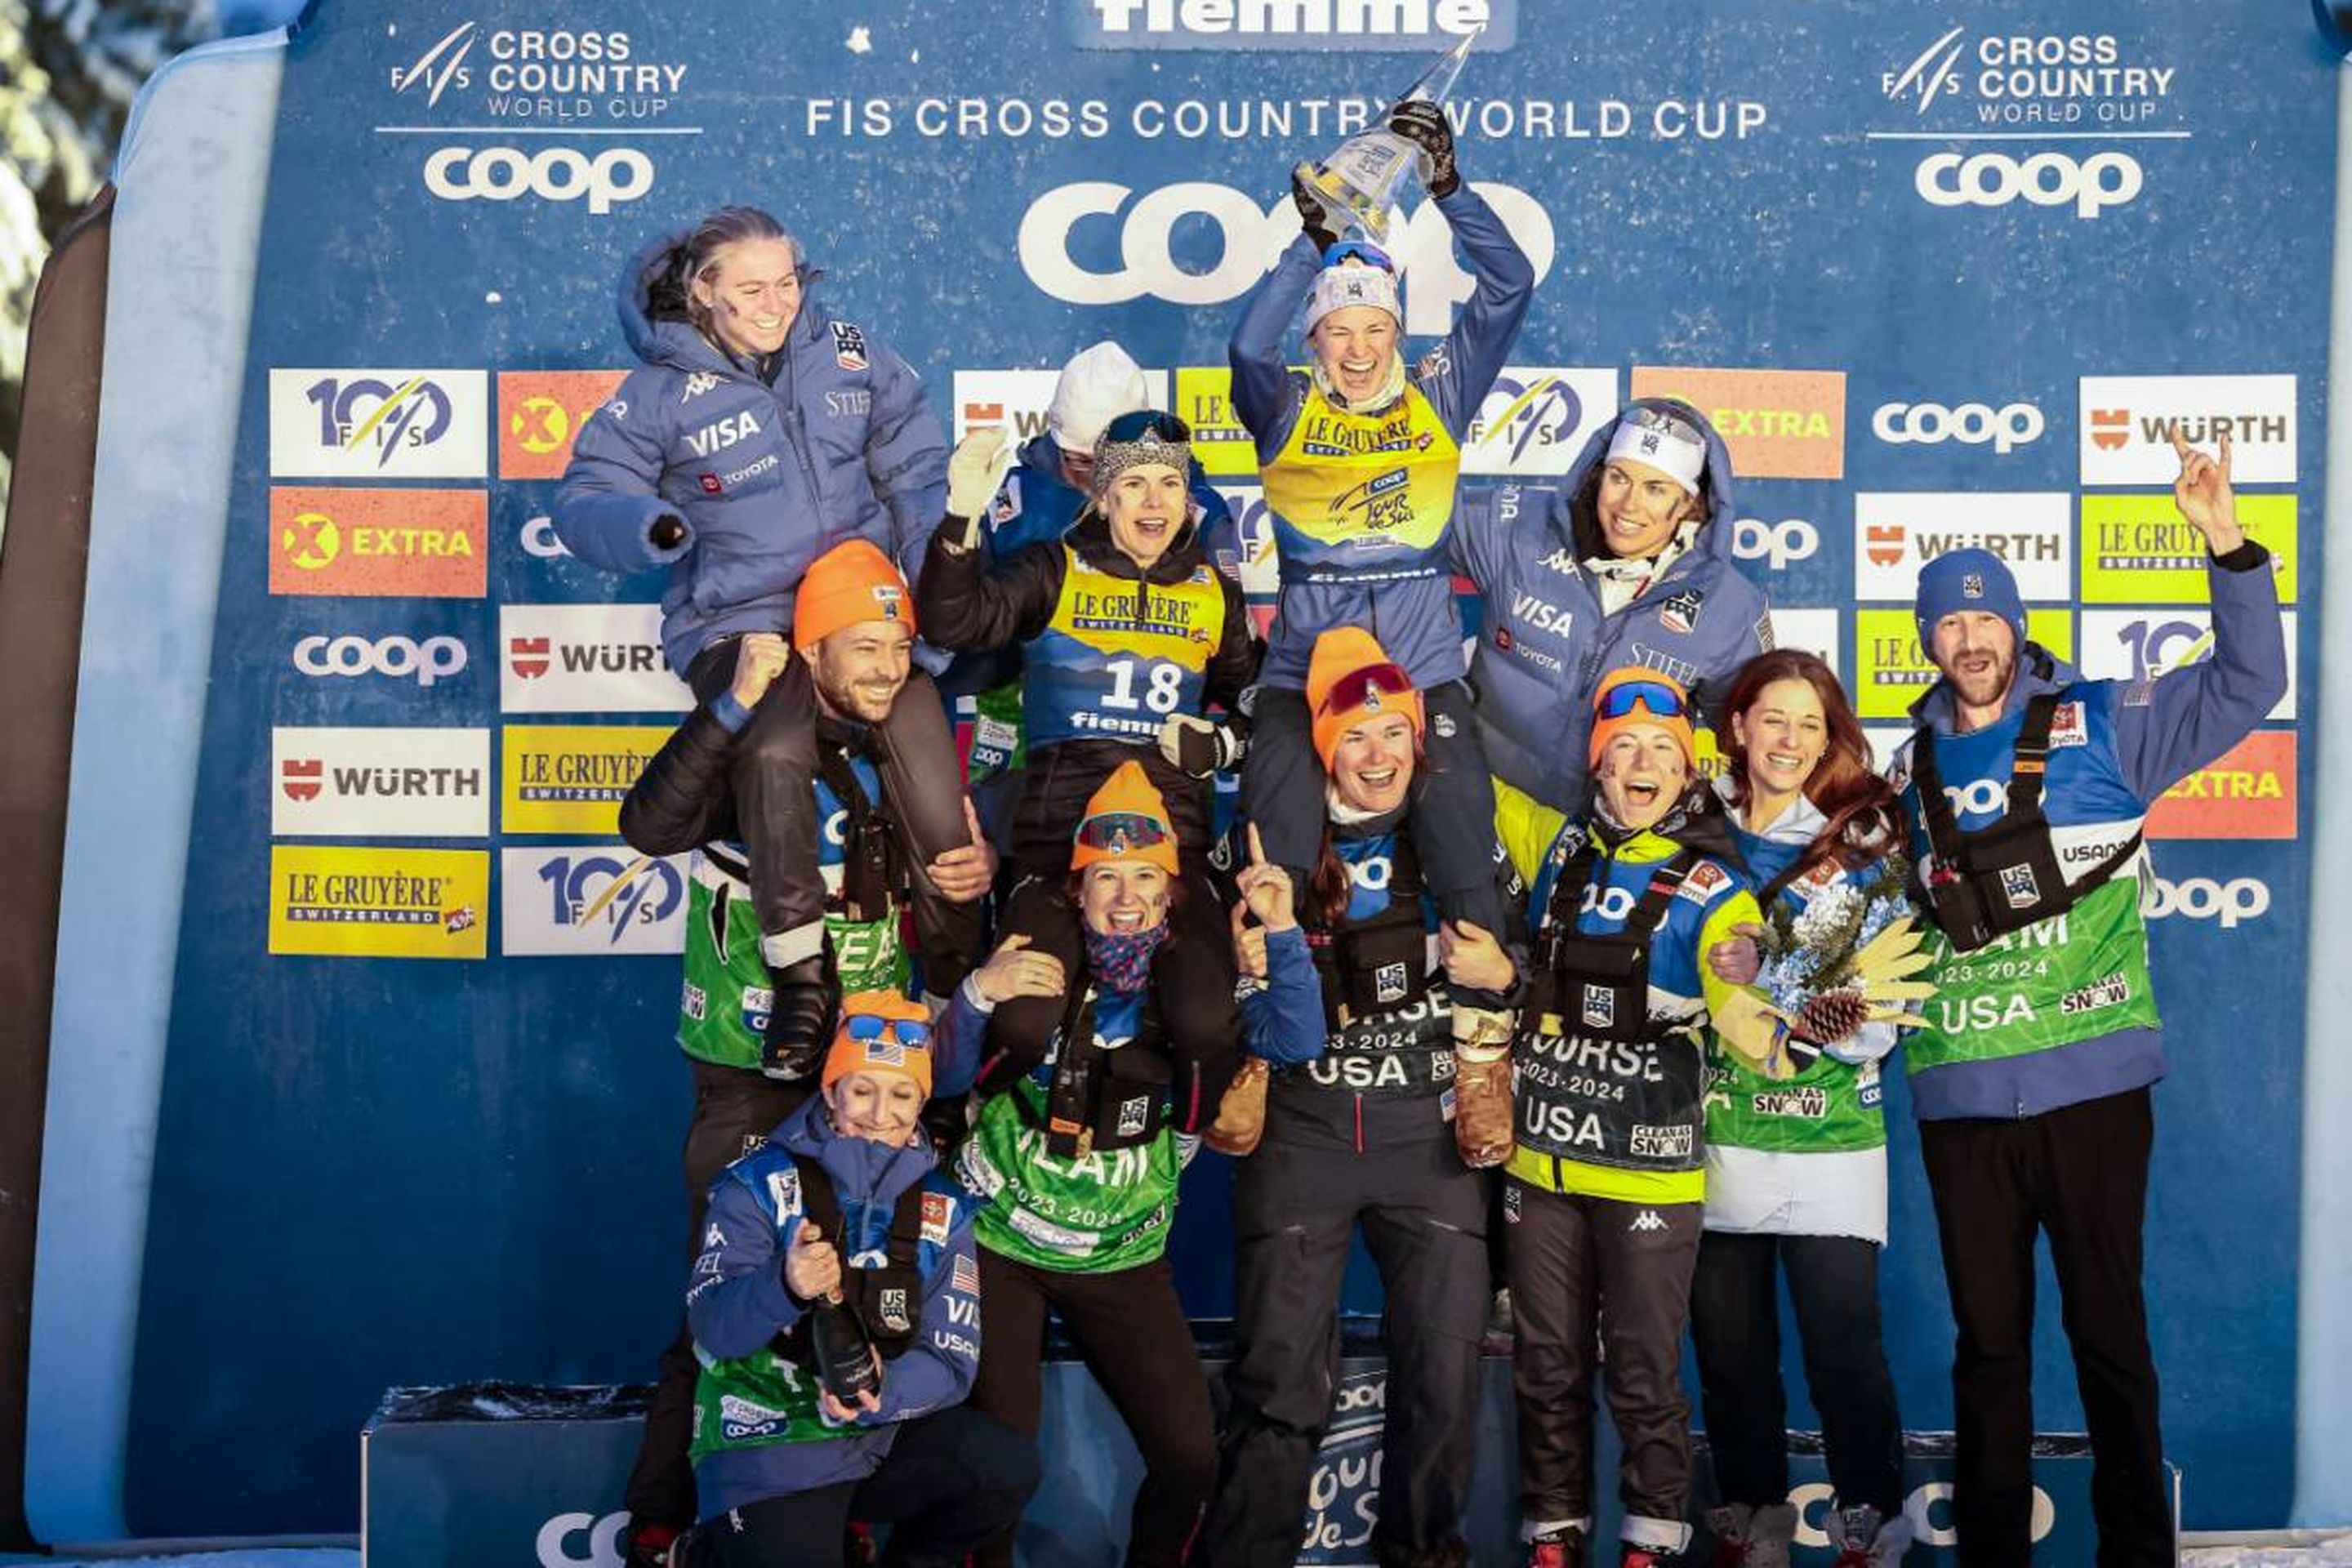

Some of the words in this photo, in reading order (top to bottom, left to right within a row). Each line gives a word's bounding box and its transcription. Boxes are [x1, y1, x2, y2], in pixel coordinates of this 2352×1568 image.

[490, 31, 630, 60] CROSS
[1979, 37, 2117, 65] CROSS
[489, 65, 688, 94] COUNTRY
[1979, 68, 2176, 97] COUNTRY
[488, 97, 594, 118] WORLD
[609, 97, 670, 118] CUP
[806, 99, 893, 137] FIS
[915, 99, 1110, 138] CROSS
[1654, 101, 1768, 140] CUP
[1977, 103, 2082, 123] WORLD
[2098, 102, 2157, 122] CUP
[424, 147, 655, 214] coop
[1915, 152, 2143, 218] coop
[831, 321, 862, 341] US
[1195, 395, 1223, 424] LE
[685, 409, 762, 458] VISA
[1872, 403, 2044, 454] coop
[724, 454, 780, 485] TOYOTA
[353, 528, 473, 557] EXTRA
[2099, 523, 2129, 552] LE
[2100, 557, 2206, 571] SWITZERL
[1073, 592, 1100, 616] LE
[1512, 590, 1574, 639] VISA
[1075, 618, 1189, 637] SWITZELAND
[292, 635, 468, 685] coop
[562, 644, 669, 673] WÜRT
[1513, 641, 1562, 673] TOYOTA
[1874, 639, 1904, 667] LE
[1099, 659, 1183, 714] 18
[520, 754, 550, 784] LE
[555, 749, 653, 784] GRUYÈ
[333, 767, 480, 797] WÜRTH
[527, 788, 623, 801] SWITZERL
[2002, 864, 2032, 884] US
[288, 874, 318, 904] LE
[292, 908, 434, 924] SWITZERLAND
[1586, 987, 1612, 1002] US
[1940, 993, 2036, 1035] USA
[1526, 1096, 1606, 1149] USA
[883, 1290, 903, 1307] US
